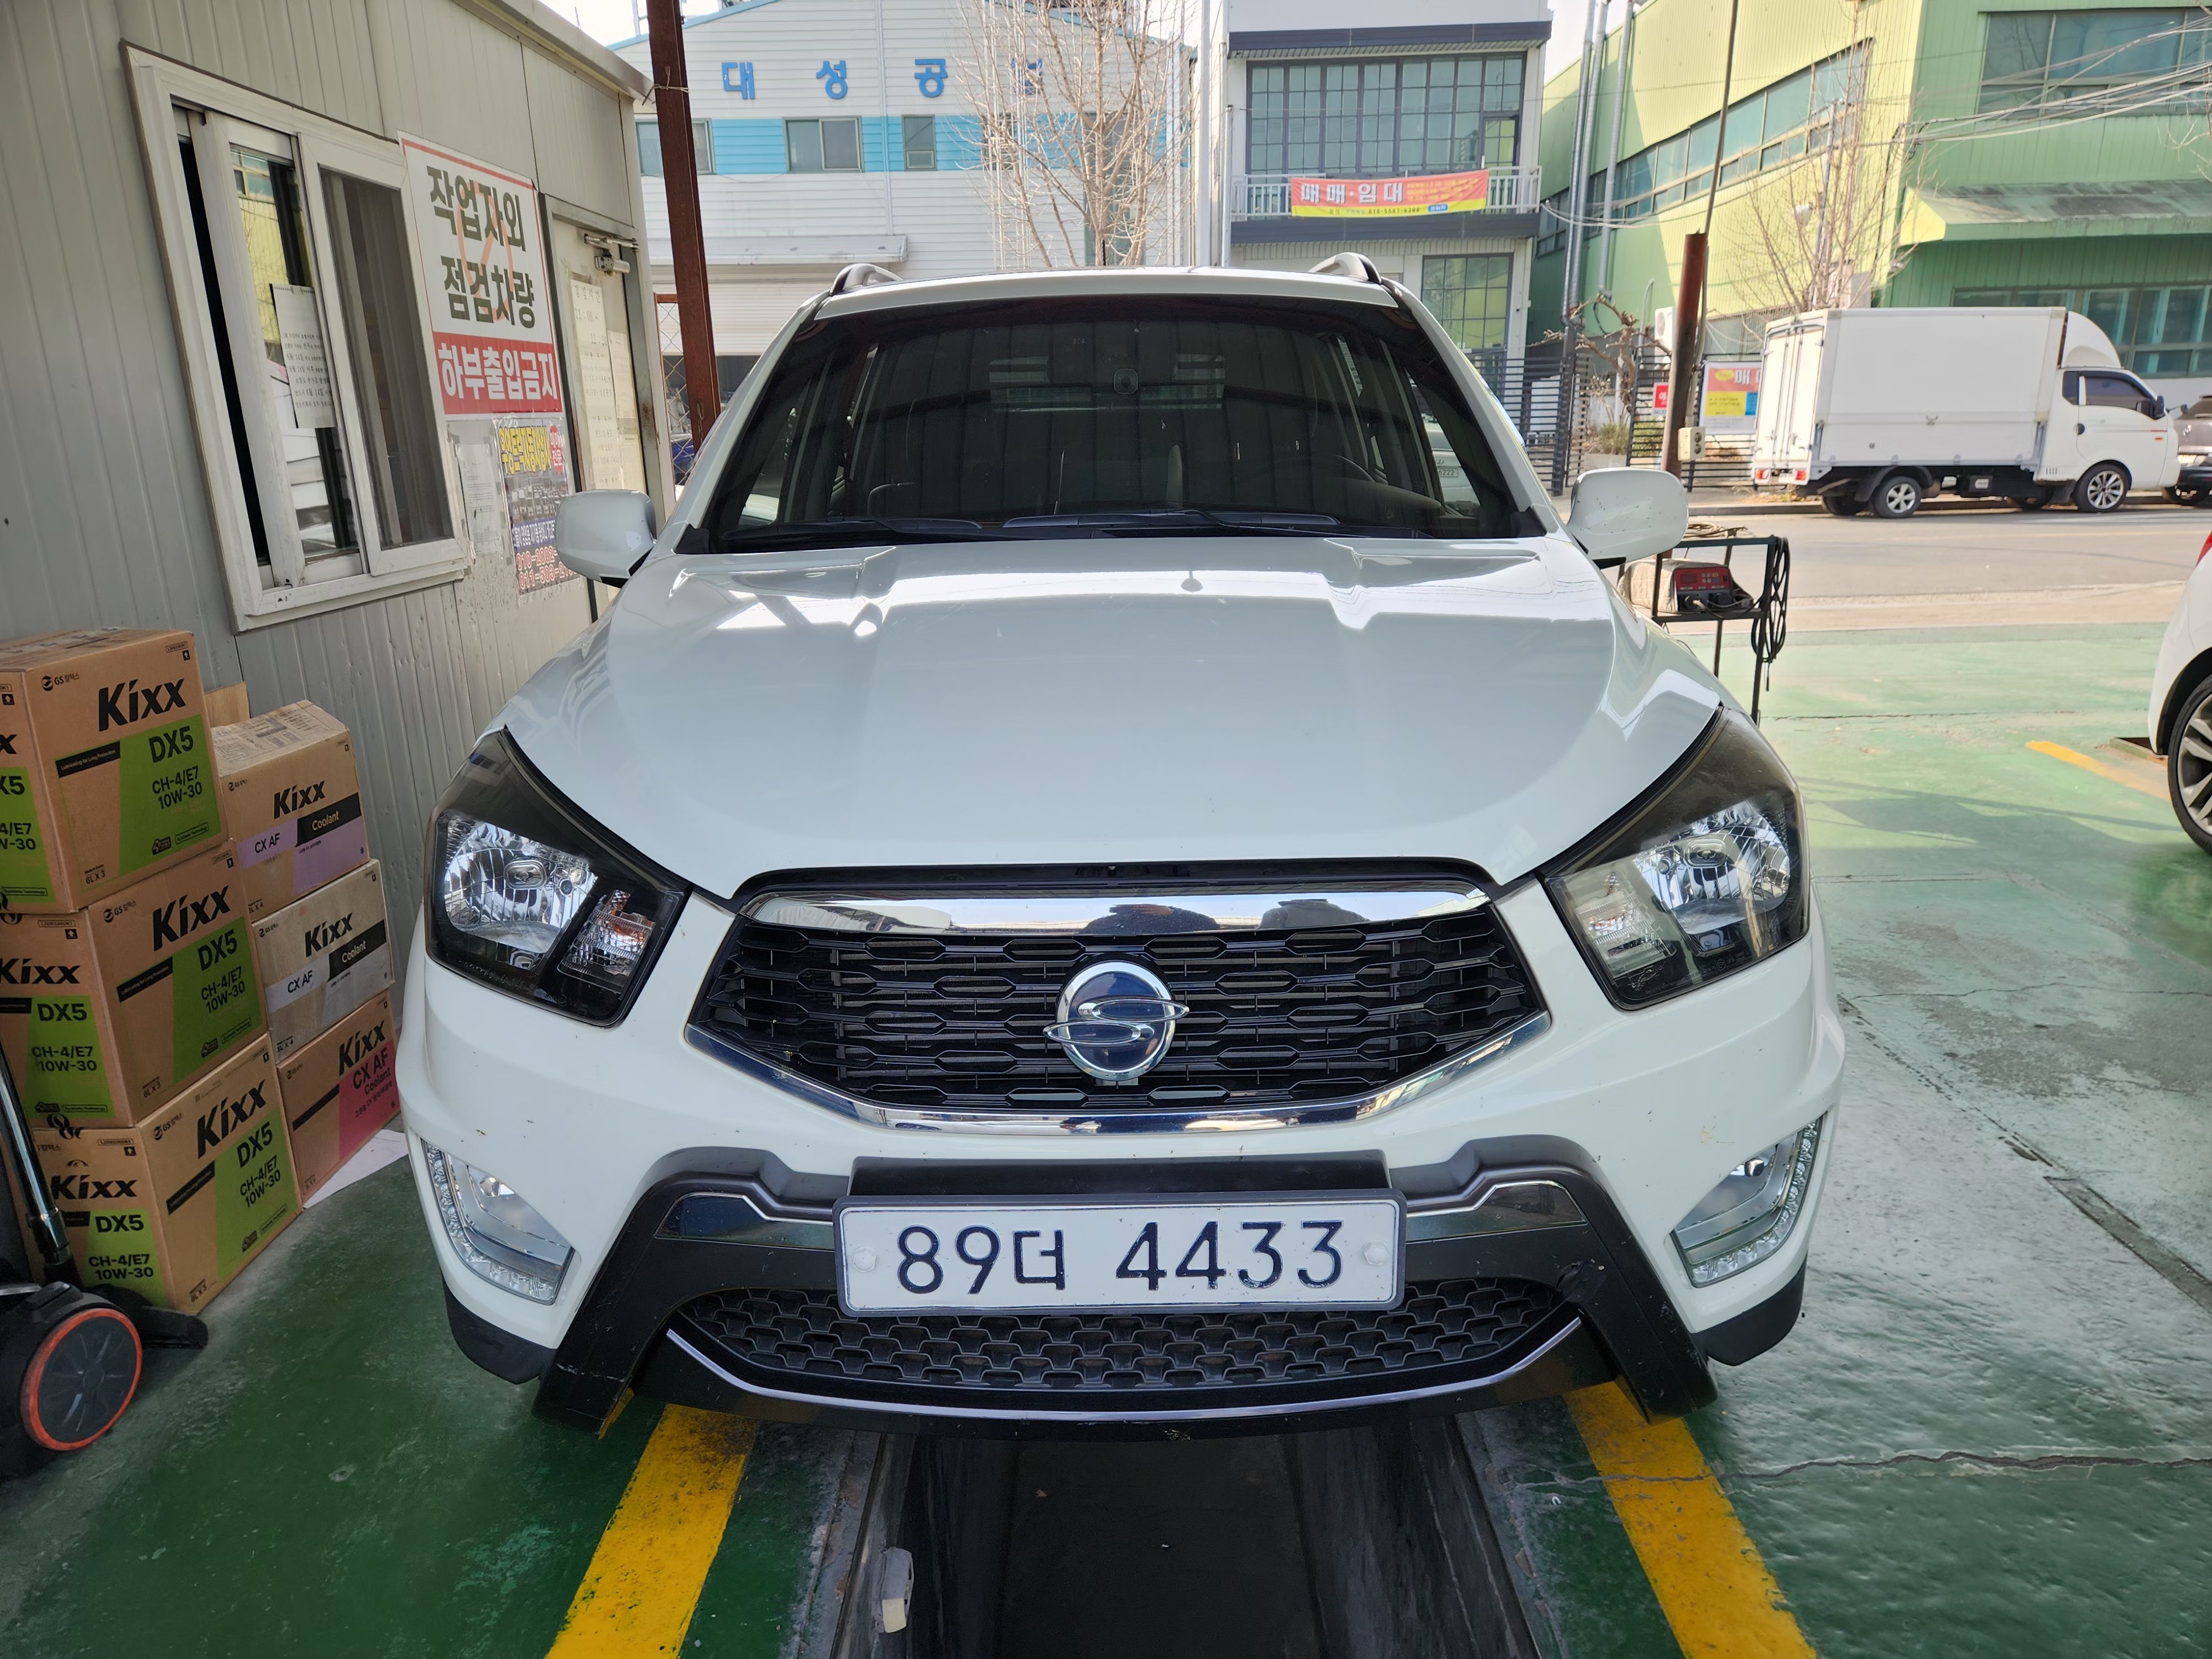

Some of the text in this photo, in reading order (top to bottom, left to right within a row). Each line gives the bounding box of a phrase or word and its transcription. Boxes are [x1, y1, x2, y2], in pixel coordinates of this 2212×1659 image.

[427, 165, 526, 252] 작업자외
[440, 255, 535, 328] 점검차량
[438, 341, 557, 400] 하부출입금지
[515, 545, 558, 571] 010-2002-
[518, 561, 577, 590] 011-503-2
[54, 675, 64, 685] GS
[98, 679, 186, 732] Kixx
[149, 725, 194, 763] DX5
[152, 765, 199, 794] CH-4/E7
[158, 781, 202, 809] 10W-30
[274, 780, 326, 819] Kixx
[312, 810, 339, 831] Coolant
[254, 832, 280, 853] CX AF
[86, 875, 95, 884] 6L
[101, 870, 106, 878] 3
[114, 906, 123, 916] GS
[153, 885, 231, 952] Kixx
[305, 912, 353, 958] Kixx
[197, 928, 238, 972] DX5
[341, 940, 366, 963] Coolant
[0, 958, 81, 984] Kixx
[201, 965, 242, 1001] CH-4/E7
[287, 977, 300, 993] CX
[302, 969, 313, 987] AF
[206, 980, 245, 1014] 10W-30
[37, 1003, 87, 1021] DX5
[31, 1046, 93, 1057] CH-4/E7
[339, 1020, 386, 1077] Kixx
[38, 1060, 97, 1072] 10W-30
[353, 1046, 389, 1089] CX AF
[364, 1067, 392, 1095] Coolant
[162, 1121, 171, 1132] GS
[197, 1079, 267, 1160] Kixx
[237, 1121, 273, 1168] DX5
[51, 1174, 137, 1200] Kixx
[239, 1155, 277, 1196] CH-4/E7
[244, 1170, 281, 1208] 10W-30
[95, 1214, 144, 1233] DX5
[88, 1254, 150, 1267] CH-4/E7
[896, 1219, 1345, 1296] 89더 4433
[95, 1267, 154, 1280] 10W-30
